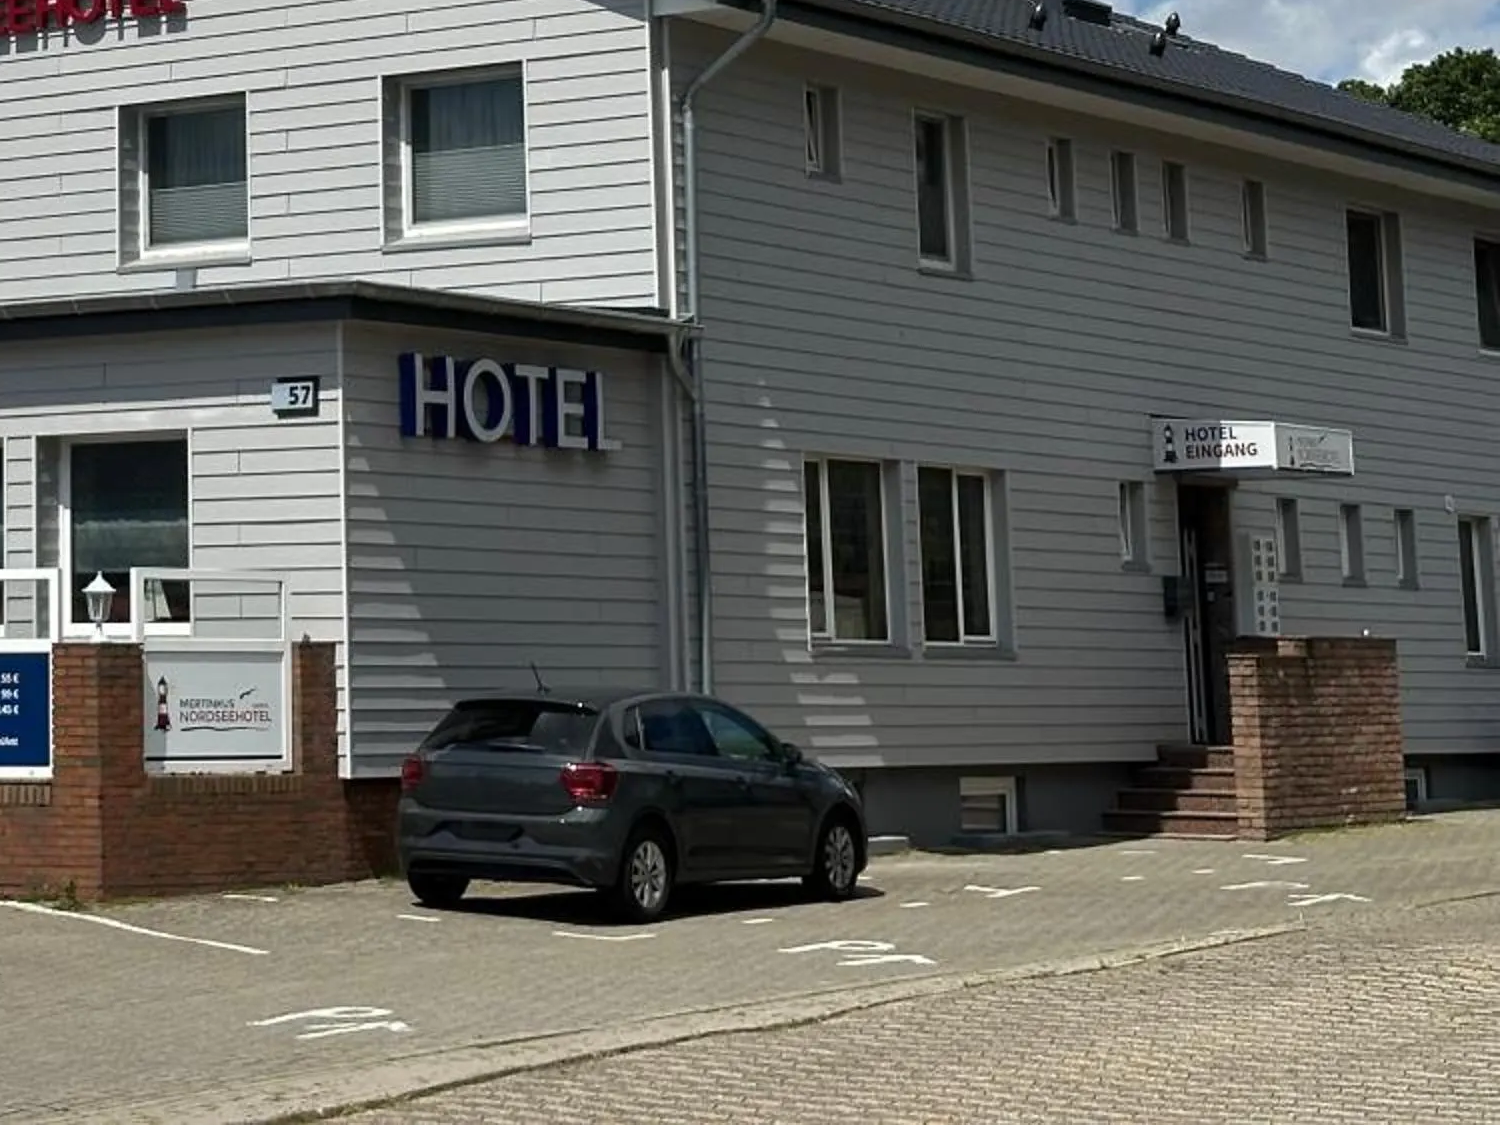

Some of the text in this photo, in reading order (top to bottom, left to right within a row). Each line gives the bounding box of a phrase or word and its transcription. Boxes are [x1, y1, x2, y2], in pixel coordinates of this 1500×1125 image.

[288, 385, 312, 406] 57
[399, 351, 623, 451] HOTEL
[1185, 426, 1238, 442] HOTEL
[1185, 442, 1259, 460] EINGANG
[180, 709, 273, 723] NORDSEEHOTEL
